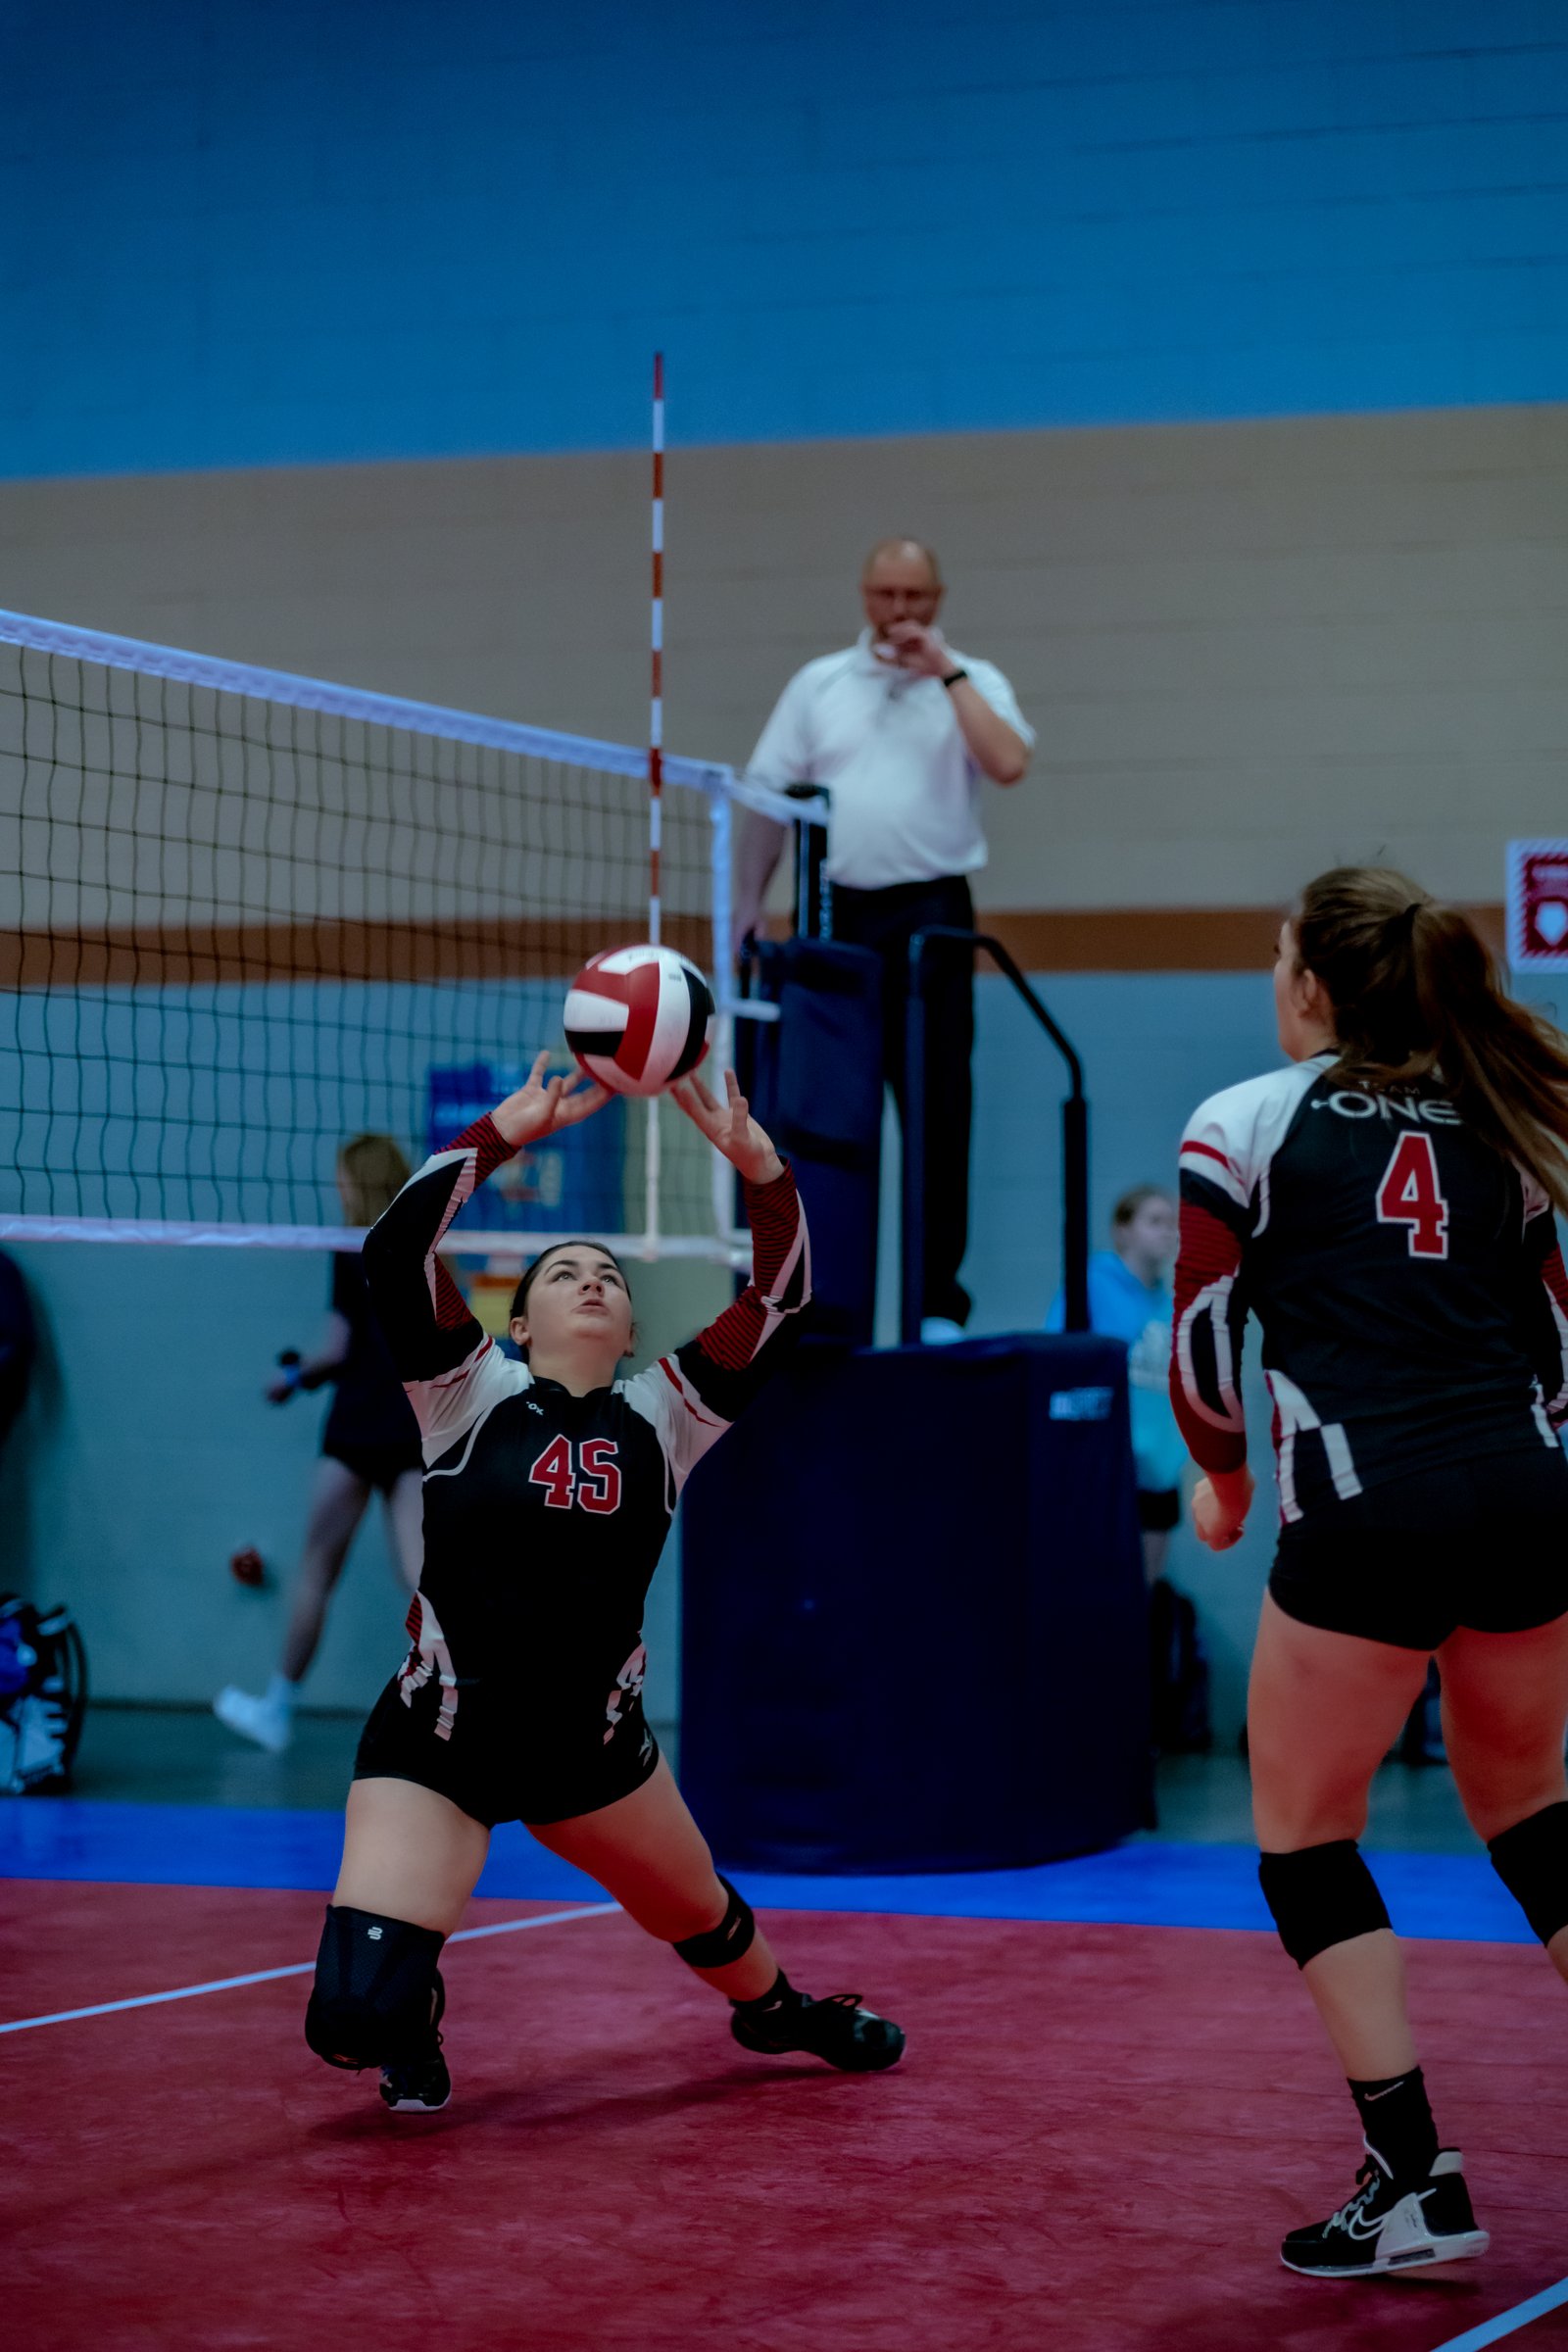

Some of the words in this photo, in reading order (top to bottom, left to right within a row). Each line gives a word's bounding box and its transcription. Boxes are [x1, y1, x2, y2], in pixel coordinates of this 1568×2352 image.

[1327, 1090, 1462, 1126] ONE
[1375, 1130, 1449, 1260] 4
[528, 1433, 622, 1515] 45
